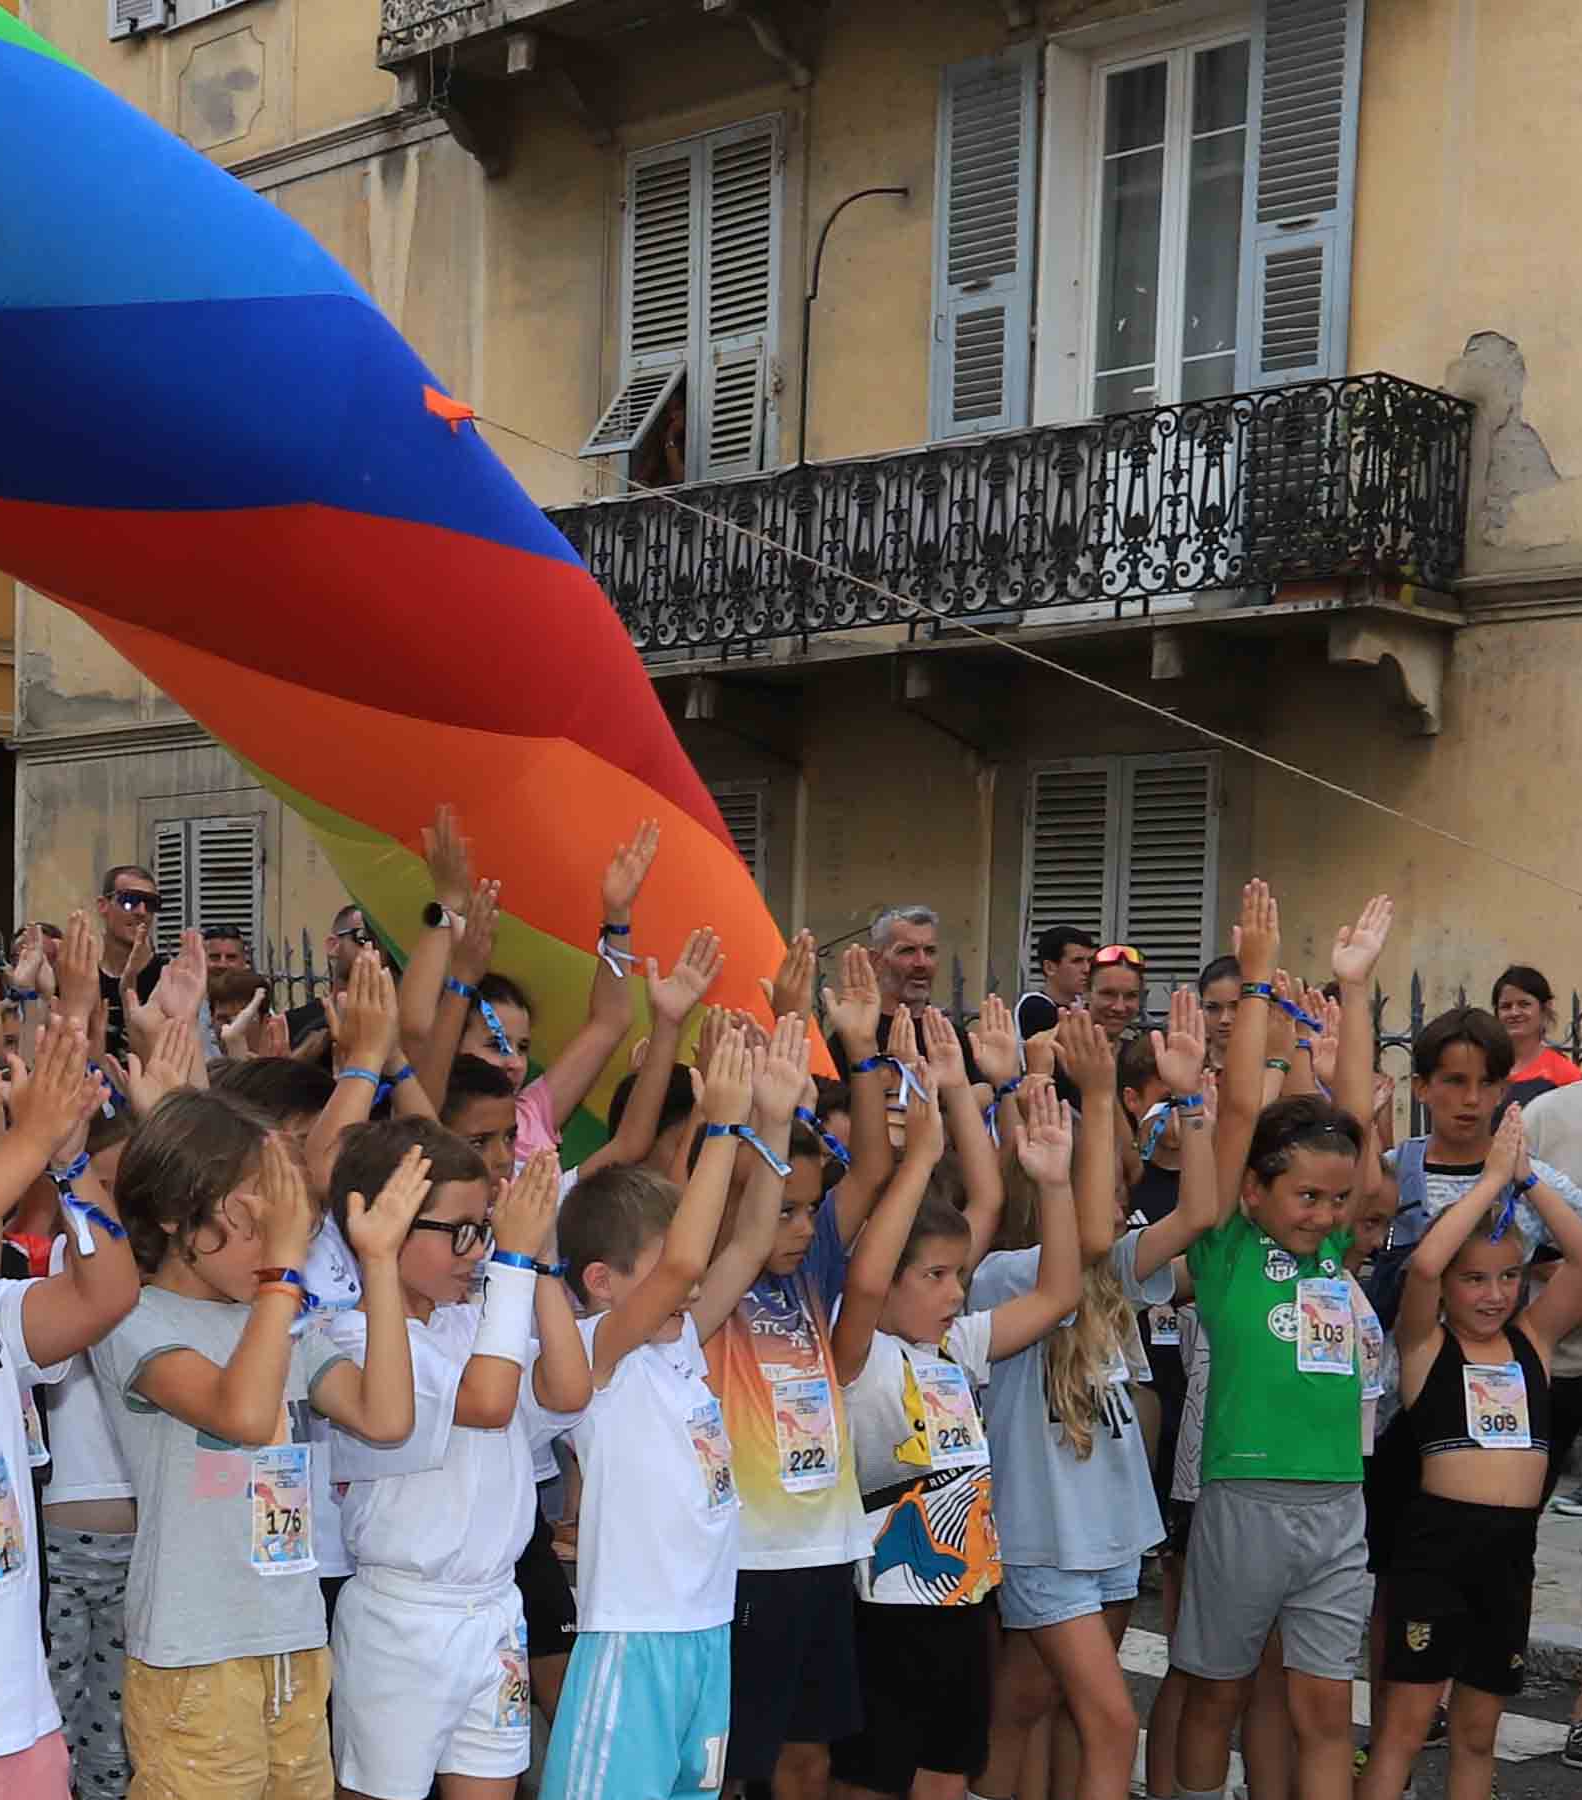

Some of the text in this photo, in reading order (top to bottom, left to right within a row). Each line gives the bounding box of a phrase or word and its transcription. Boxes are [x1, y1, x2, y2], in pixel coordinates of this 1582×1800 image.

[1311, 1322, 1345, 1344] 103
[1480, 1414, 1518, 1433] 309
[937, 1426, 972, 1450] 226
[789, 1446, 827, 1473] 222
[266, 1508, 302, 1535] 176
